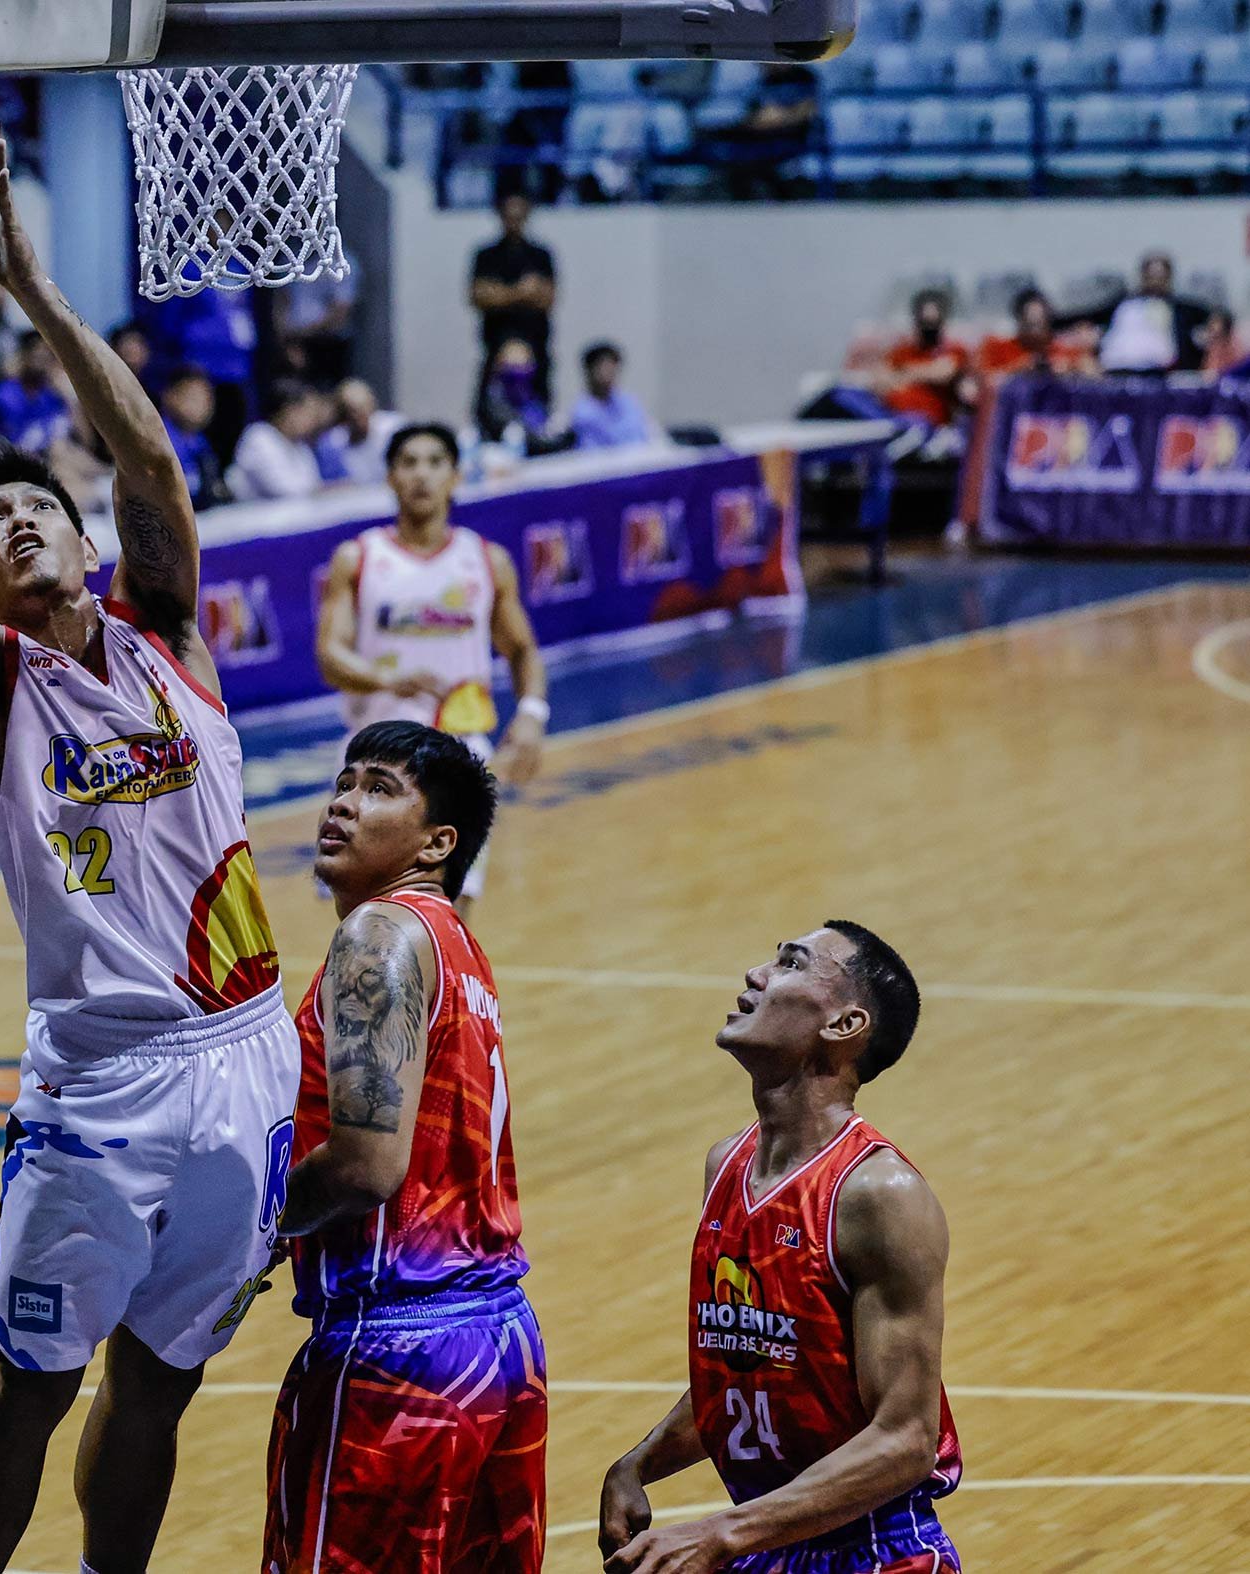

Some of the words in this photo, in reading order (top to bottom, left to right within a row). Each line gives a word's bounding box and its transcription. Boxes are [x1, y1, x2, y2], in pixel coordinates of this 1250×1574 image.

[27, 655, 54, 669] ANTA
[113, 750, 127, 760] OR
[45, 826, 116, 896] 22
[489, 1044, 508, 1187] 1
[17, 1295, 51, 1313] Sista
[726, 1388, 786, 1460] 24
